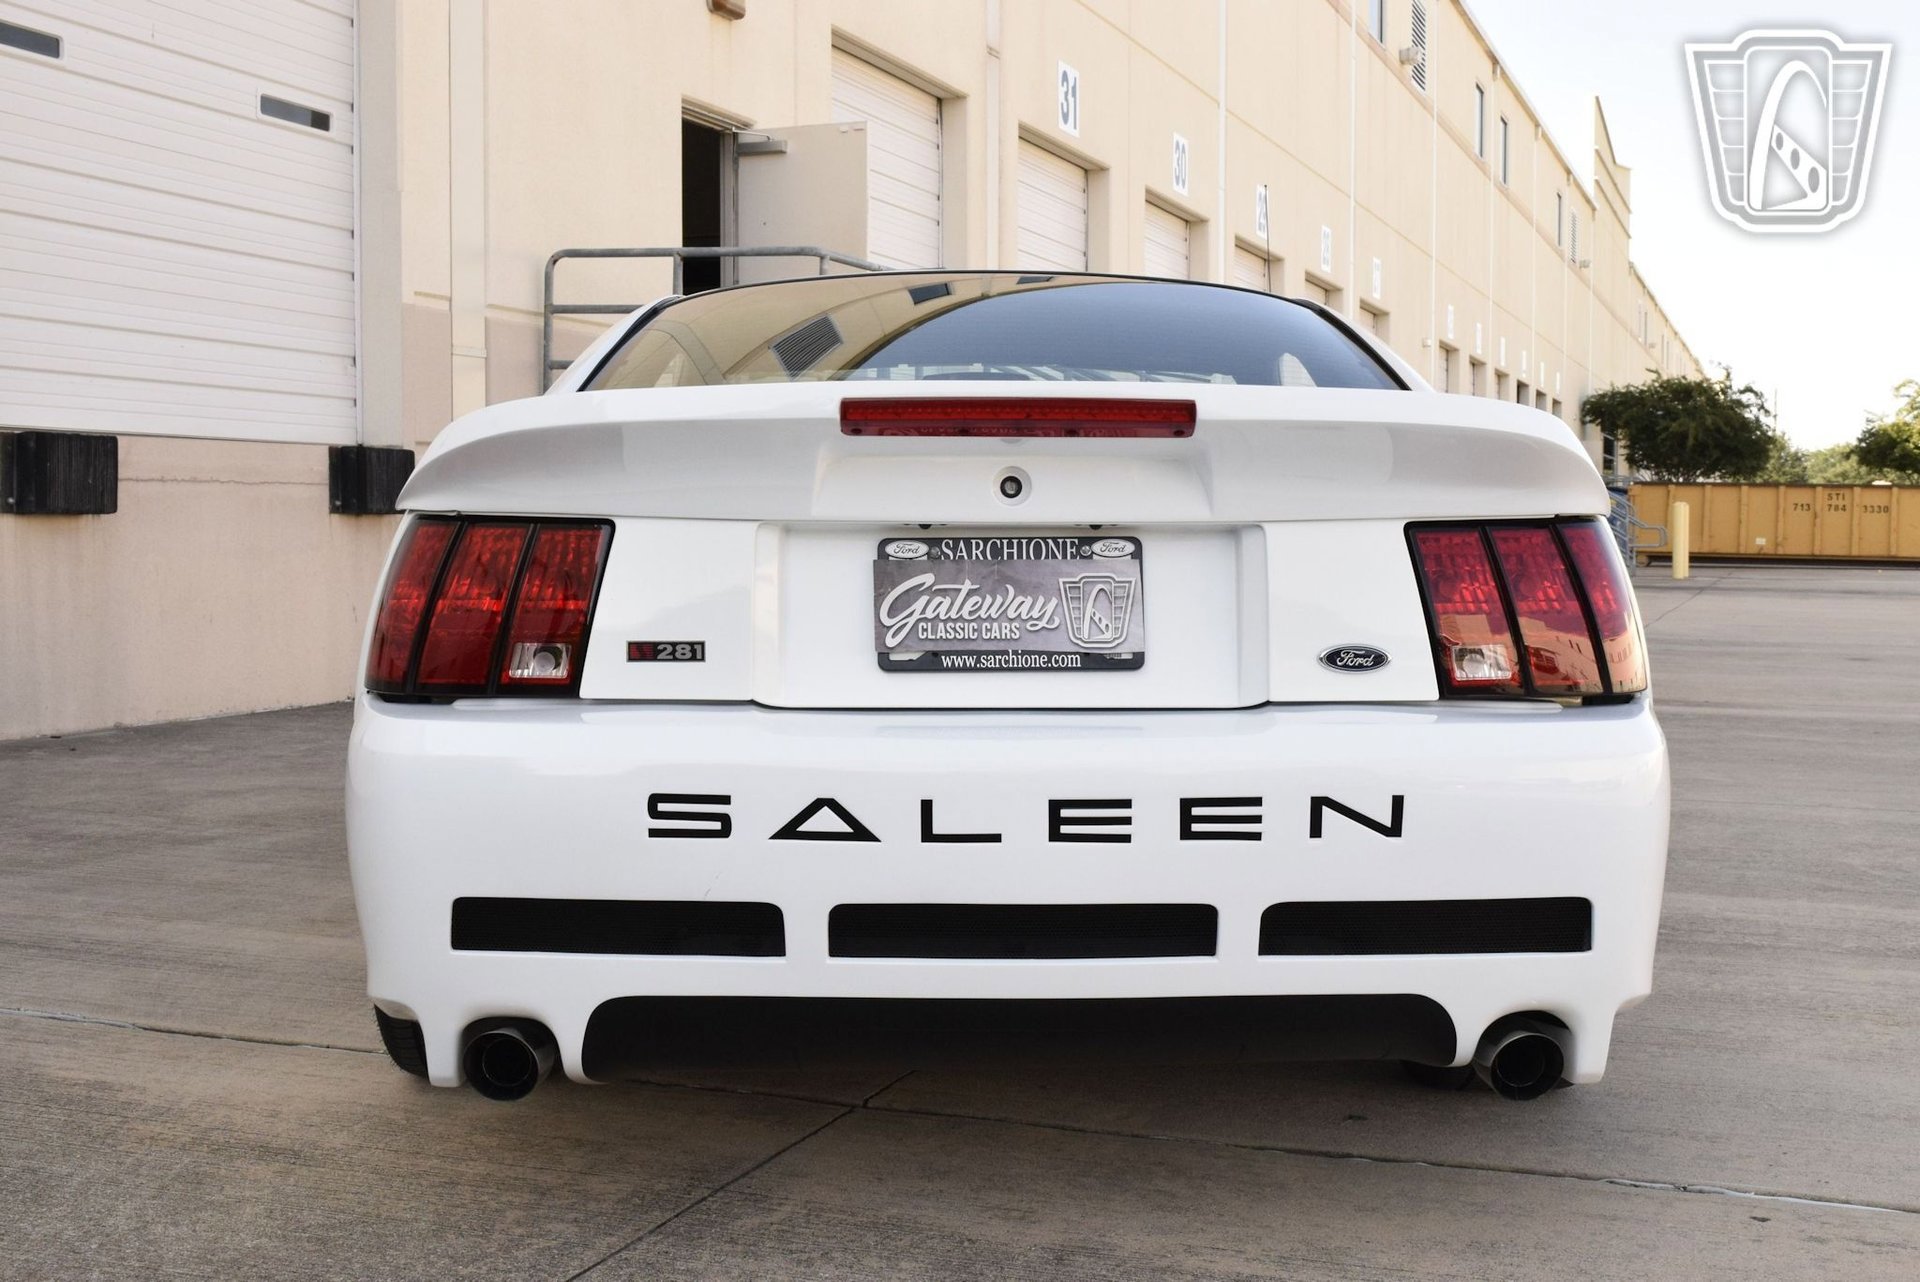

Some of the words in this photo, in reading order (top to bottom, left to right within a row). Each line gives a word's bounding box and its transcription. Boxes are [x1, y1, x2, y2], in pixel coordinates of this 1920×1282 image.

[1060, 70, 1077, 130] 31
[1174, 140, 1187, 189] 30
[1827, 493, 1846, 501] STI
[1792, 503, 1811, 512] 713
[1827, 504, 1847, 512] 784
[1862, 505, 1889, 514] 3330
[894, 543, 921, 555] Ford
[940, 538, 1080, 560] SARCHIONE
[1100, 542, 1126, 554] Ford
[879, 573, 1060, 648] Gateway
[918, 623, 978, 640] CLASSIC
[982, 623, 1020, 640] CARS
[940, 650, 1081, 668] www.sarchione.com
[1336, 649, 1375, 666] Ford
[647, 793, 1404, 843] SALEEN
